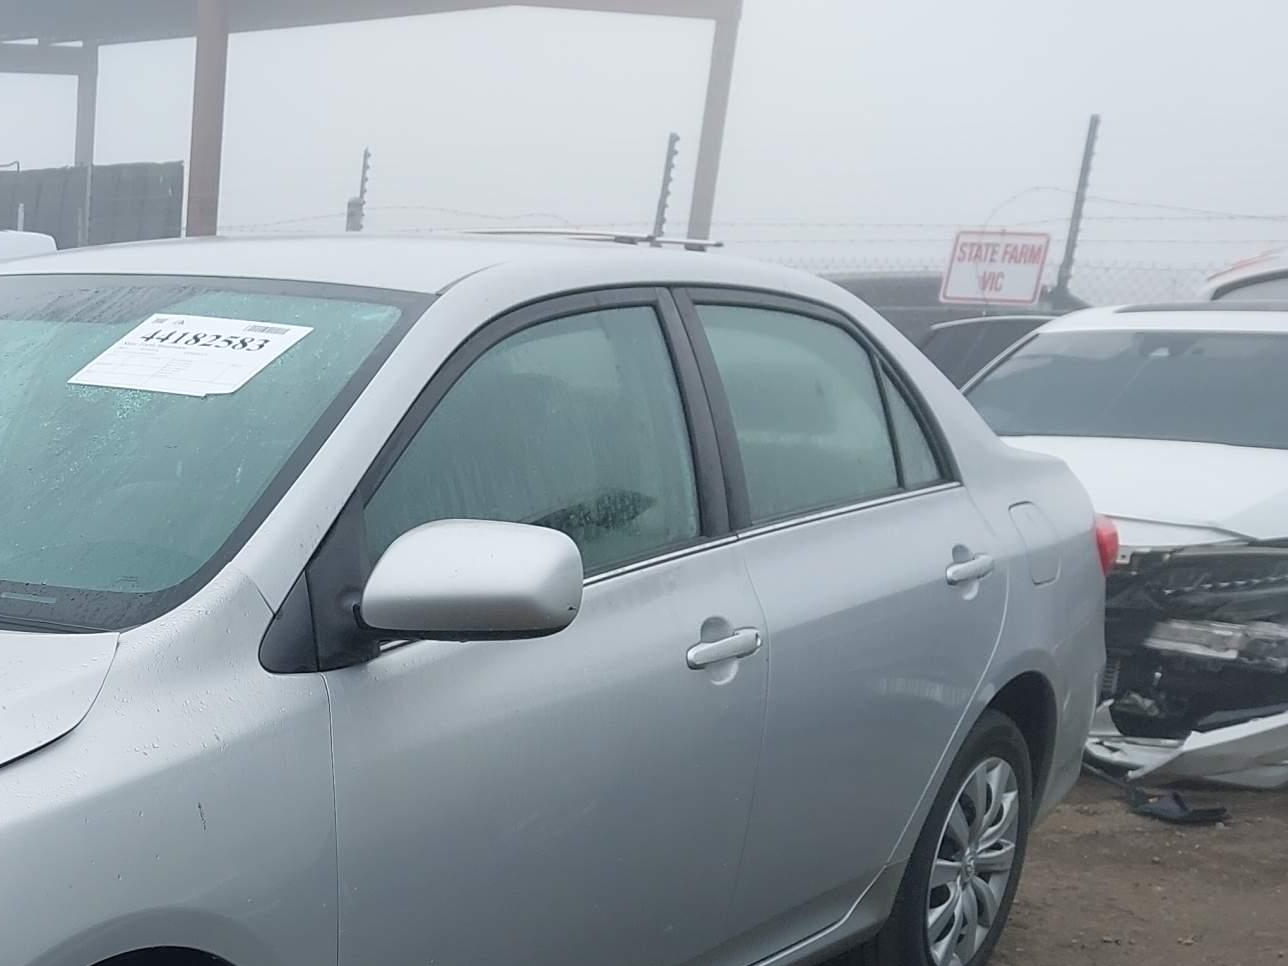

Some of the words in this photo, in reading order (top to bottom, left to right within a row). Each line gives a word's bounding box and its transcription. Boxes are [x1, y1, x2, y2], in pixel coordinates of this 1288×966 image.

[956, 242, 1001, 263] STATE
[1001, 243, 1044, 265] FARM
[977, 271, 1005, 292] VIC
[141, 328, 271, 352] 44182583
